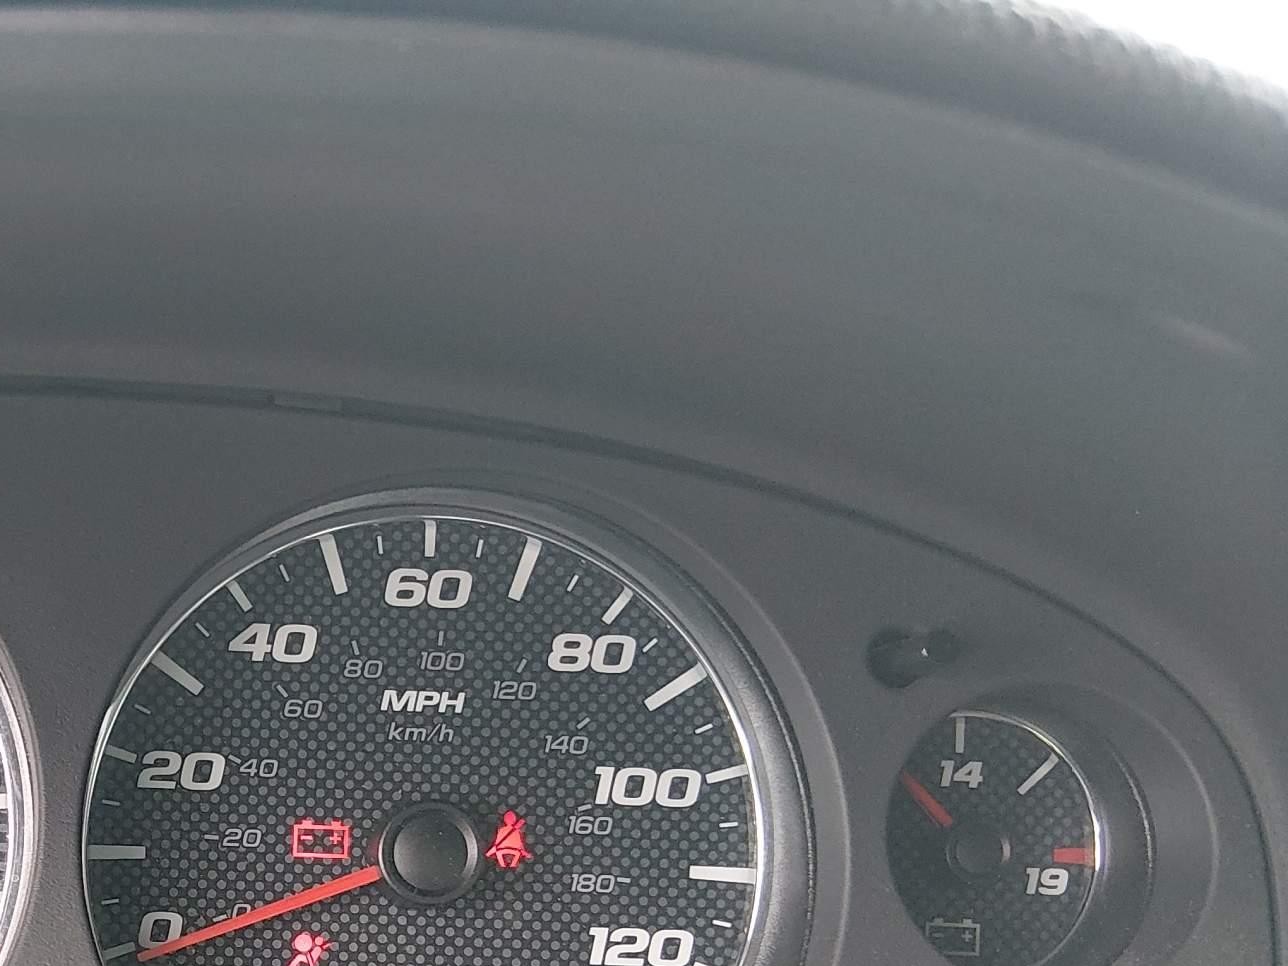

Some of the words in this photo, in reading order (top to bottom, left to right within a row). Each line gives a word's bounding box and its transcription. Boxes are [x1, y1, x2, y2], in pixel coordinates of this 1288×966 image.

[384, 568, 473, 609] 60
[227, 623, 318, 663] 40
[547, 633, 636, 674] 80
[343, 659, 384, 679] 80
[419, 652, 465, 672] 100
[492, 680, 537, 700] 120
[283, 699, 323, 719] 60
[380, 690, 465, 714] MPH
[387, 722, 455, 743] km/h
[544, 735, 589, 755] 140
[137, 751, 226, 791] 20
[239, 758, 279, 778] 40
[939, 760, 984, 789] 14
[594, 766, 702, 808] 100
[568, 816, 613, 836] 160
[222, 828, 262, 848] 20
[570, 874, 616, 894] 180
[1025, 867, 1069, 896] 19
[138, 911, 184, 949] 0
